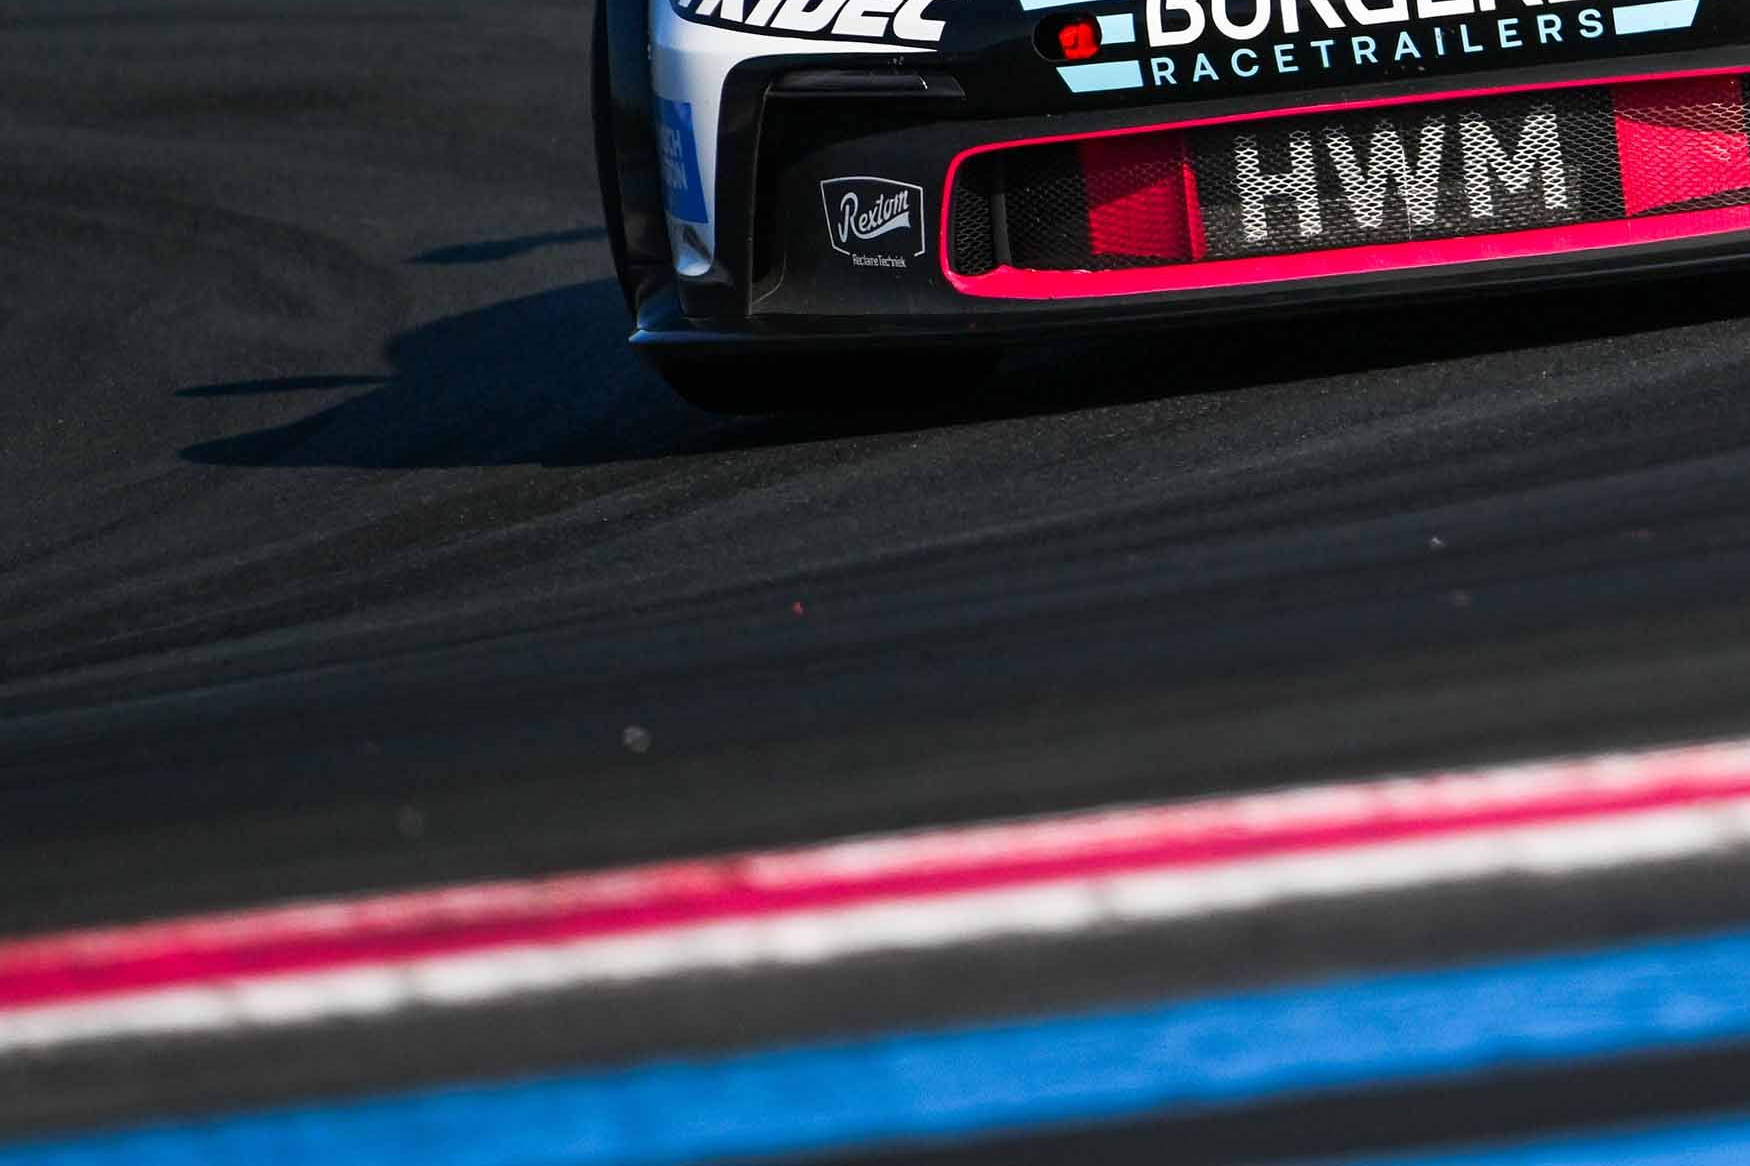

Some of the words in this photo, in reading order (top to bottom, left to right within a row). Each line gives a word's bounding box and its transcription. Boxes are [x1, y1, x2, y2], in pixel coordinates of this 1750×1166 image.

[1151, 8, 1605, 87] RACETRAILERS
[1234, 102, 1568, 244] HWM
[838, 189, 912, 243] Rextom
